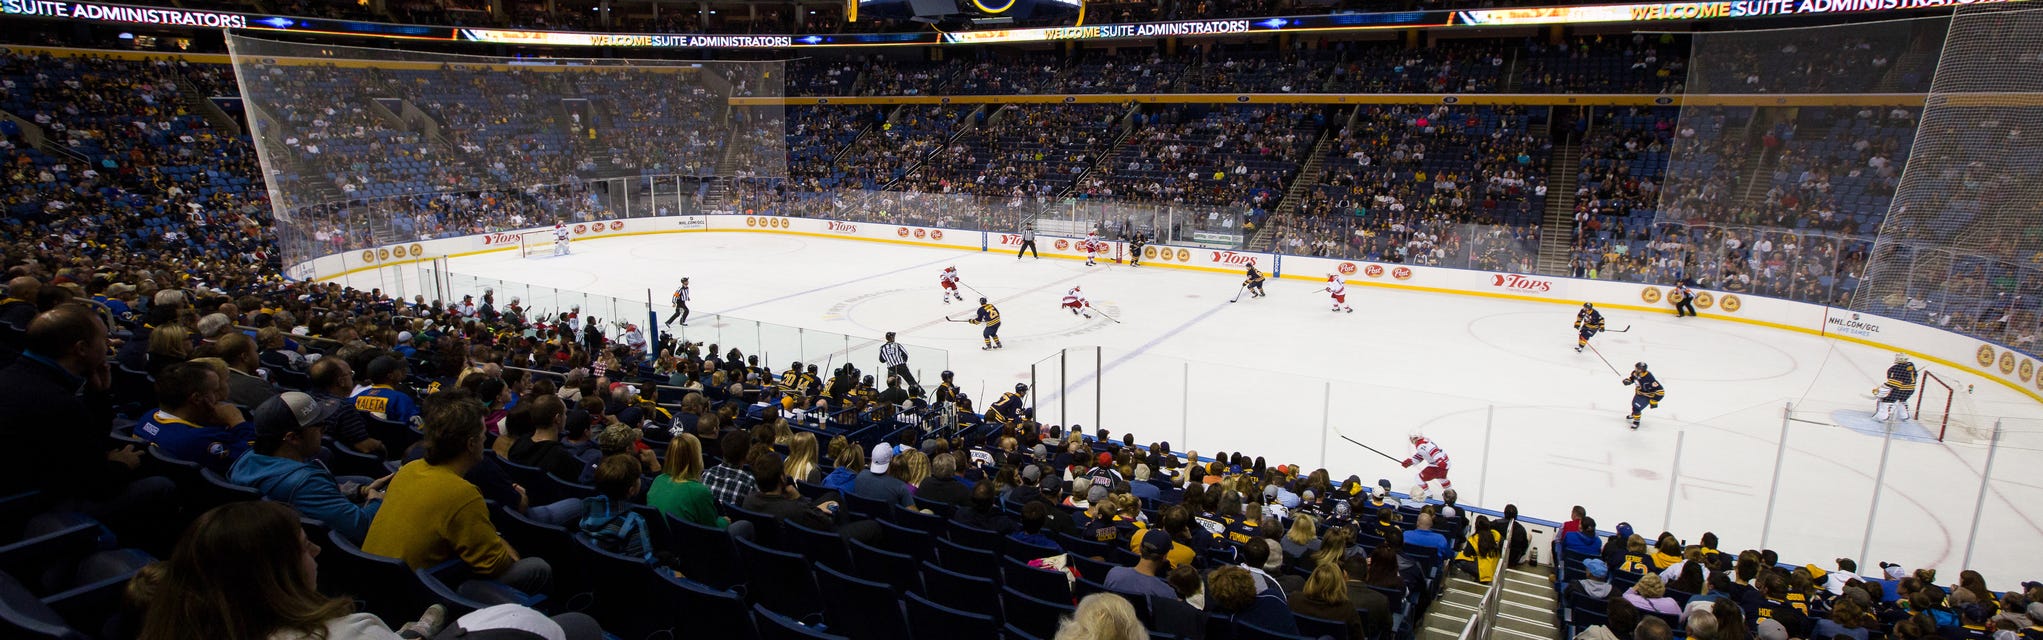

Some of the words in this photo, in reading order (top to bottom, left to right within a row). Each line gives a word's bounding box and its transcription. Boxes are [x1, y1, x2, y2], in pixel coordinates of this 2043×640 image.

[7, 0, 69, 17] SUITE
[73, 4, 246, 28] ADMINISTRATORS!
[1630, 3, 1731, 20] WELCOME
[1735, 0, 1793, 17] SUITE
[1044, 26, 1100, 39] WELCOME
[1104, 24, 1134, 36] SUITE
[1137, 20, 1249, 36] ADMINISTRATORS!
[590, 35, 652, 47] WELCOME
[655, 36, 687, 46] SUITE
[689, 36, 791, 47] ADMINISTRATORS!
[1829, 317, 1880, 333] NHL.COM/GCL
